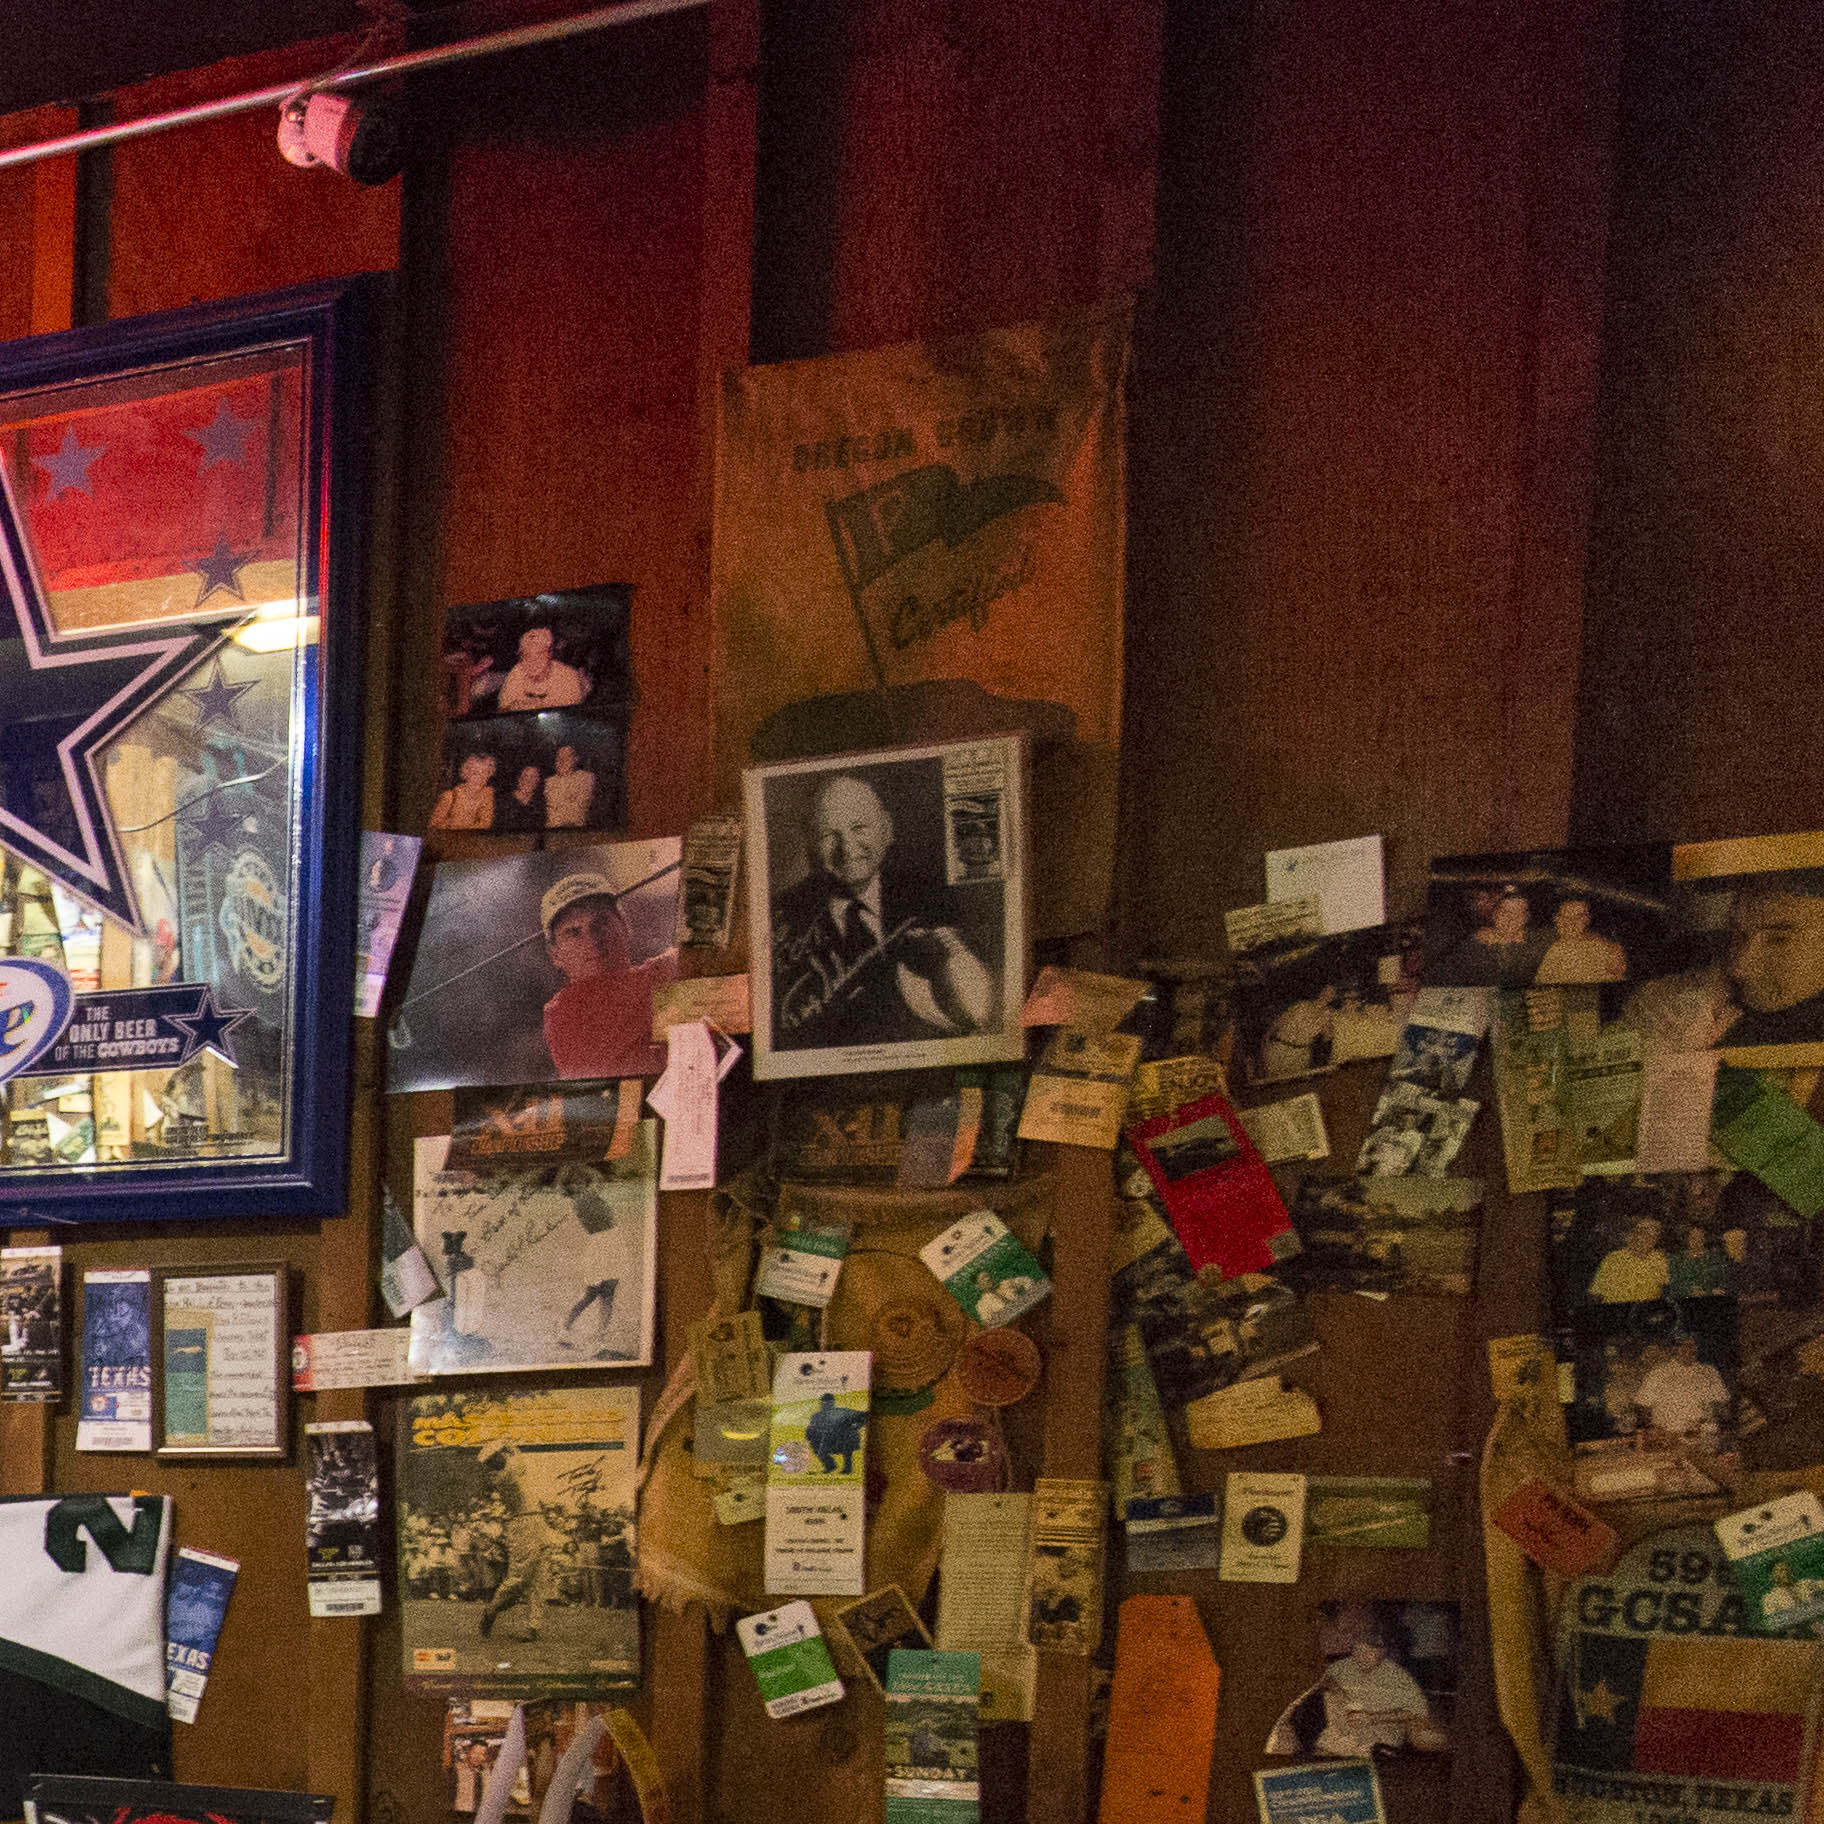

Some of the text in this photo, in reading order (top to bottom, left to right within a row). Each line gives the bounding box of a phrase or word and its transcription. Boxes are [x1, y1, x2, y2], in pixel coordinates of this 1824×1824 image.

[84, 1005, 112, 1021] THE
[68, 1017, 158, 1043] ONLY BEER
[55, 1039, 182, 1061] OF THE COWBOYS
[88, 1364, 152, 1389] TEXAS
[1578, 1584, 1756, 1637] GCSA
[166, 1642, 211, 1670] EXAS
